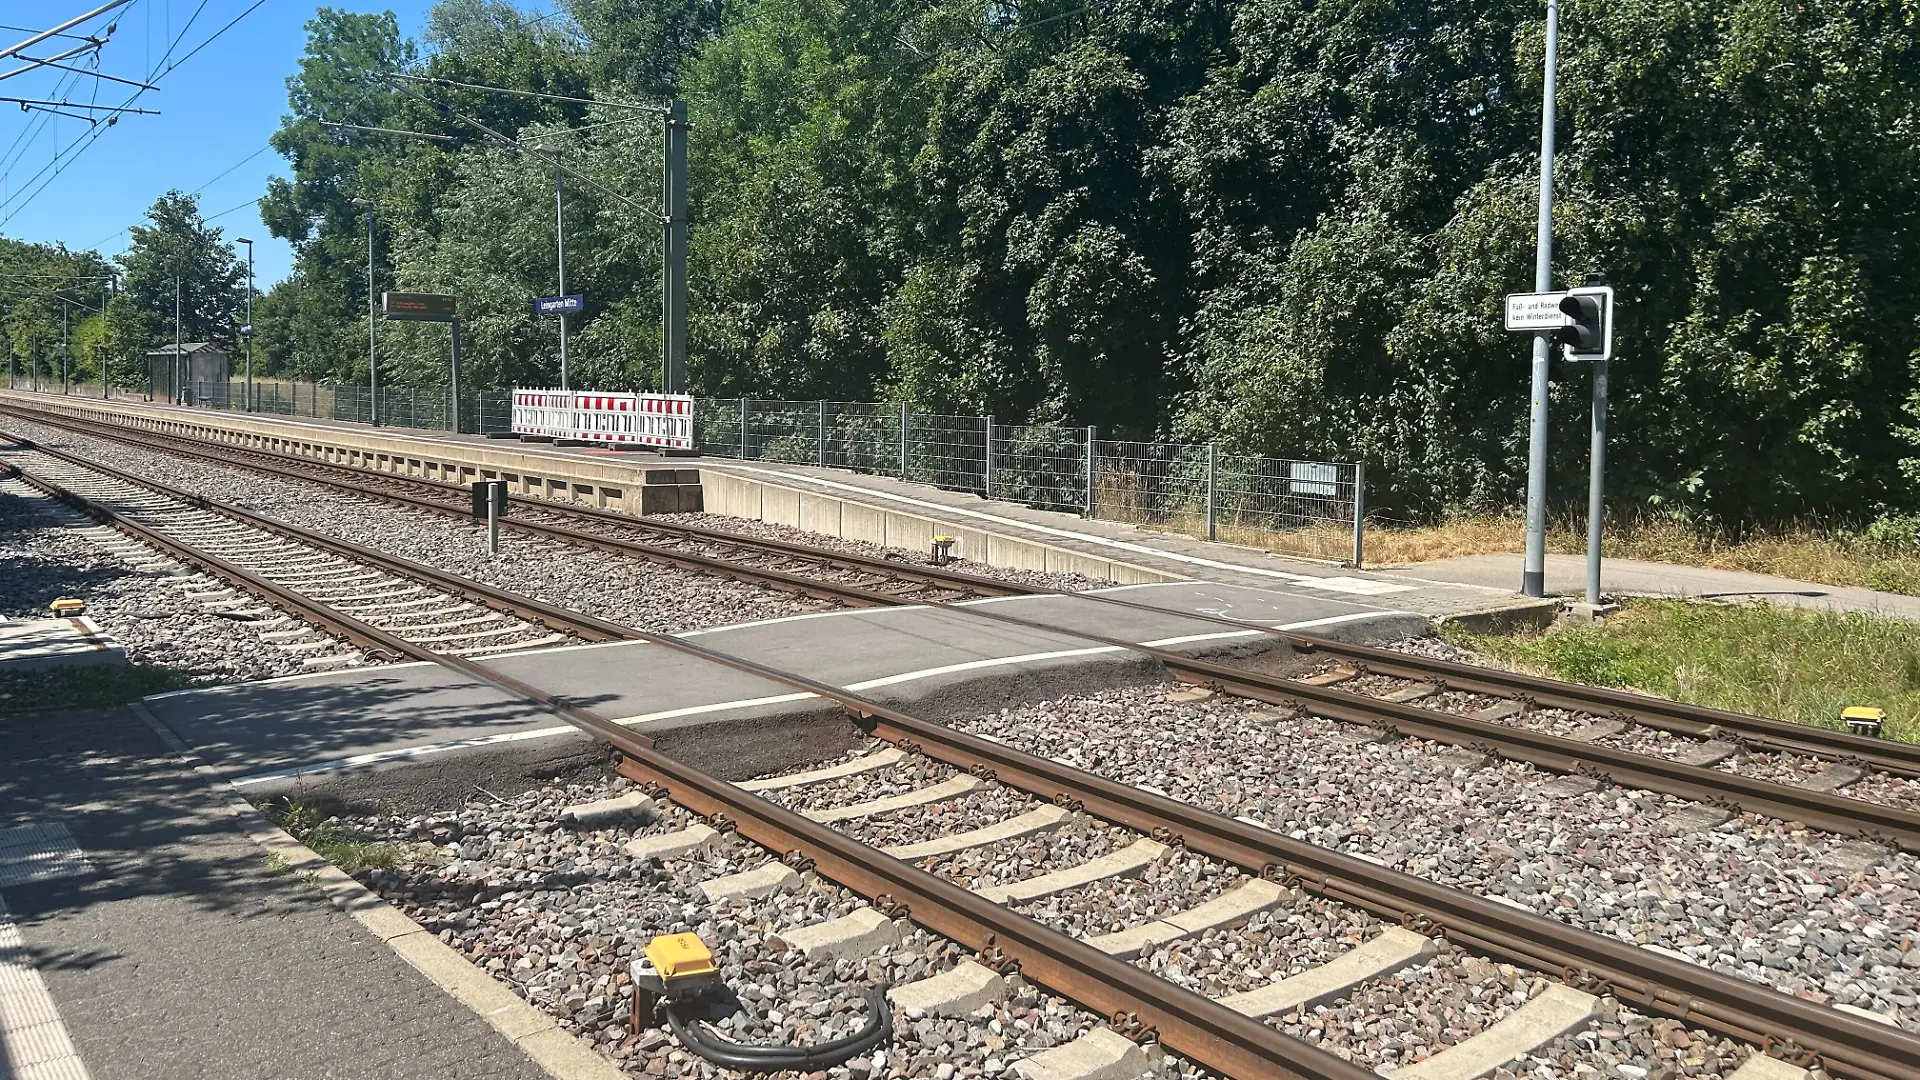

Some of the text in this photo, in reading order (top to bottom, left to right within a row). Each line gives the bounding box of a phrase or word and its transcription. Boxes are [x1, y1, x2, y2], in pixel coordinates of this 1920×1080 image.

[540, 298, 577, 310] Leingarten Mitte
[1528, 302, 1538, 310] und
[1527, 312, 1562, 320] Winterdienst
